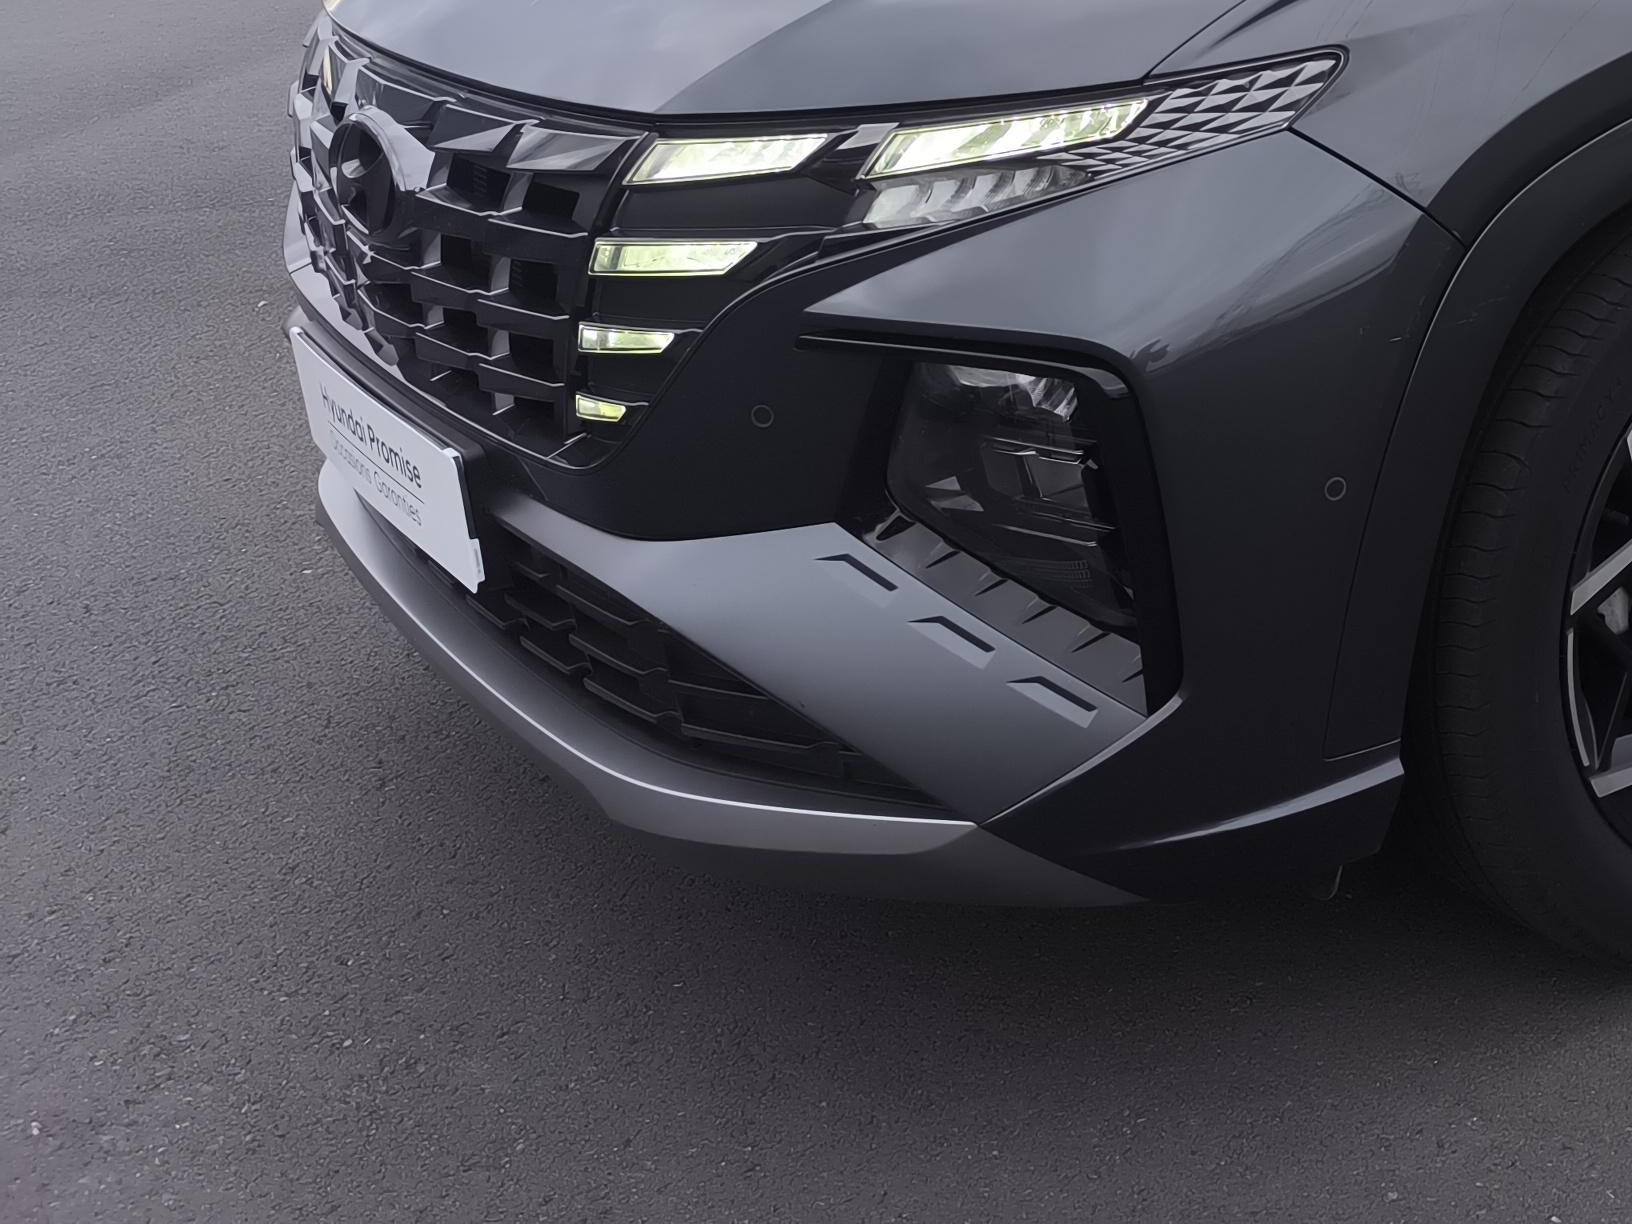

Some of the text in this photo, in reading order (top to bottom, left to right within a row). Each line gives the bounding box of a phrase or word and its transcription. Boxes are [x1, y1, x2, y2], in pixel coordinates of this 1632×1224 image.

[320, 382, 422, 489] Hyundai Promise
[373, 470, 422, 527] Garanties
